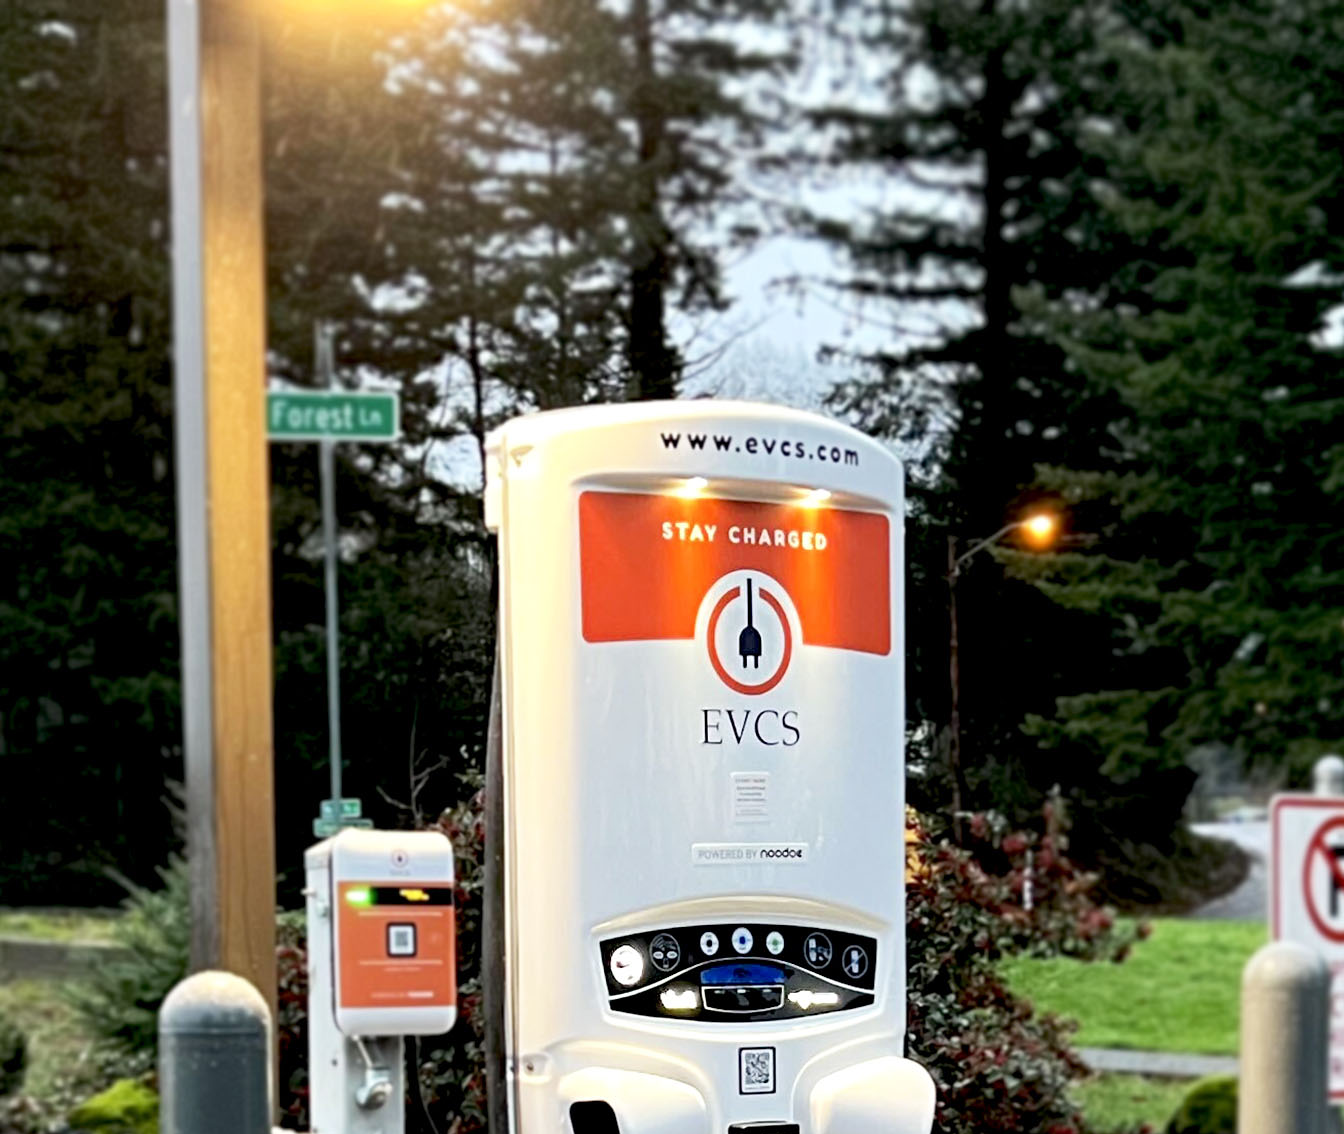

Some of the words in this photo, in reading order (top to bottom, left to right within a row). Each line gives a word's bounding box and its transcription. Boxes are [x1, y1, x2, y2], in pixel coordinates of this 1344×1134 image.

[271, 400, 353, 429] Forest
[359, 407, 382, 426] Ln
[660, 432, 861, 467] www.evcs.com
[662, 521, 717, 542] STAY
[728, 525, 828, 551] CHARGED
[700, 708, 801, 746] EVCS
[698, 849, 743, 860] POWERED
[746, 848, 757, 859] BY
